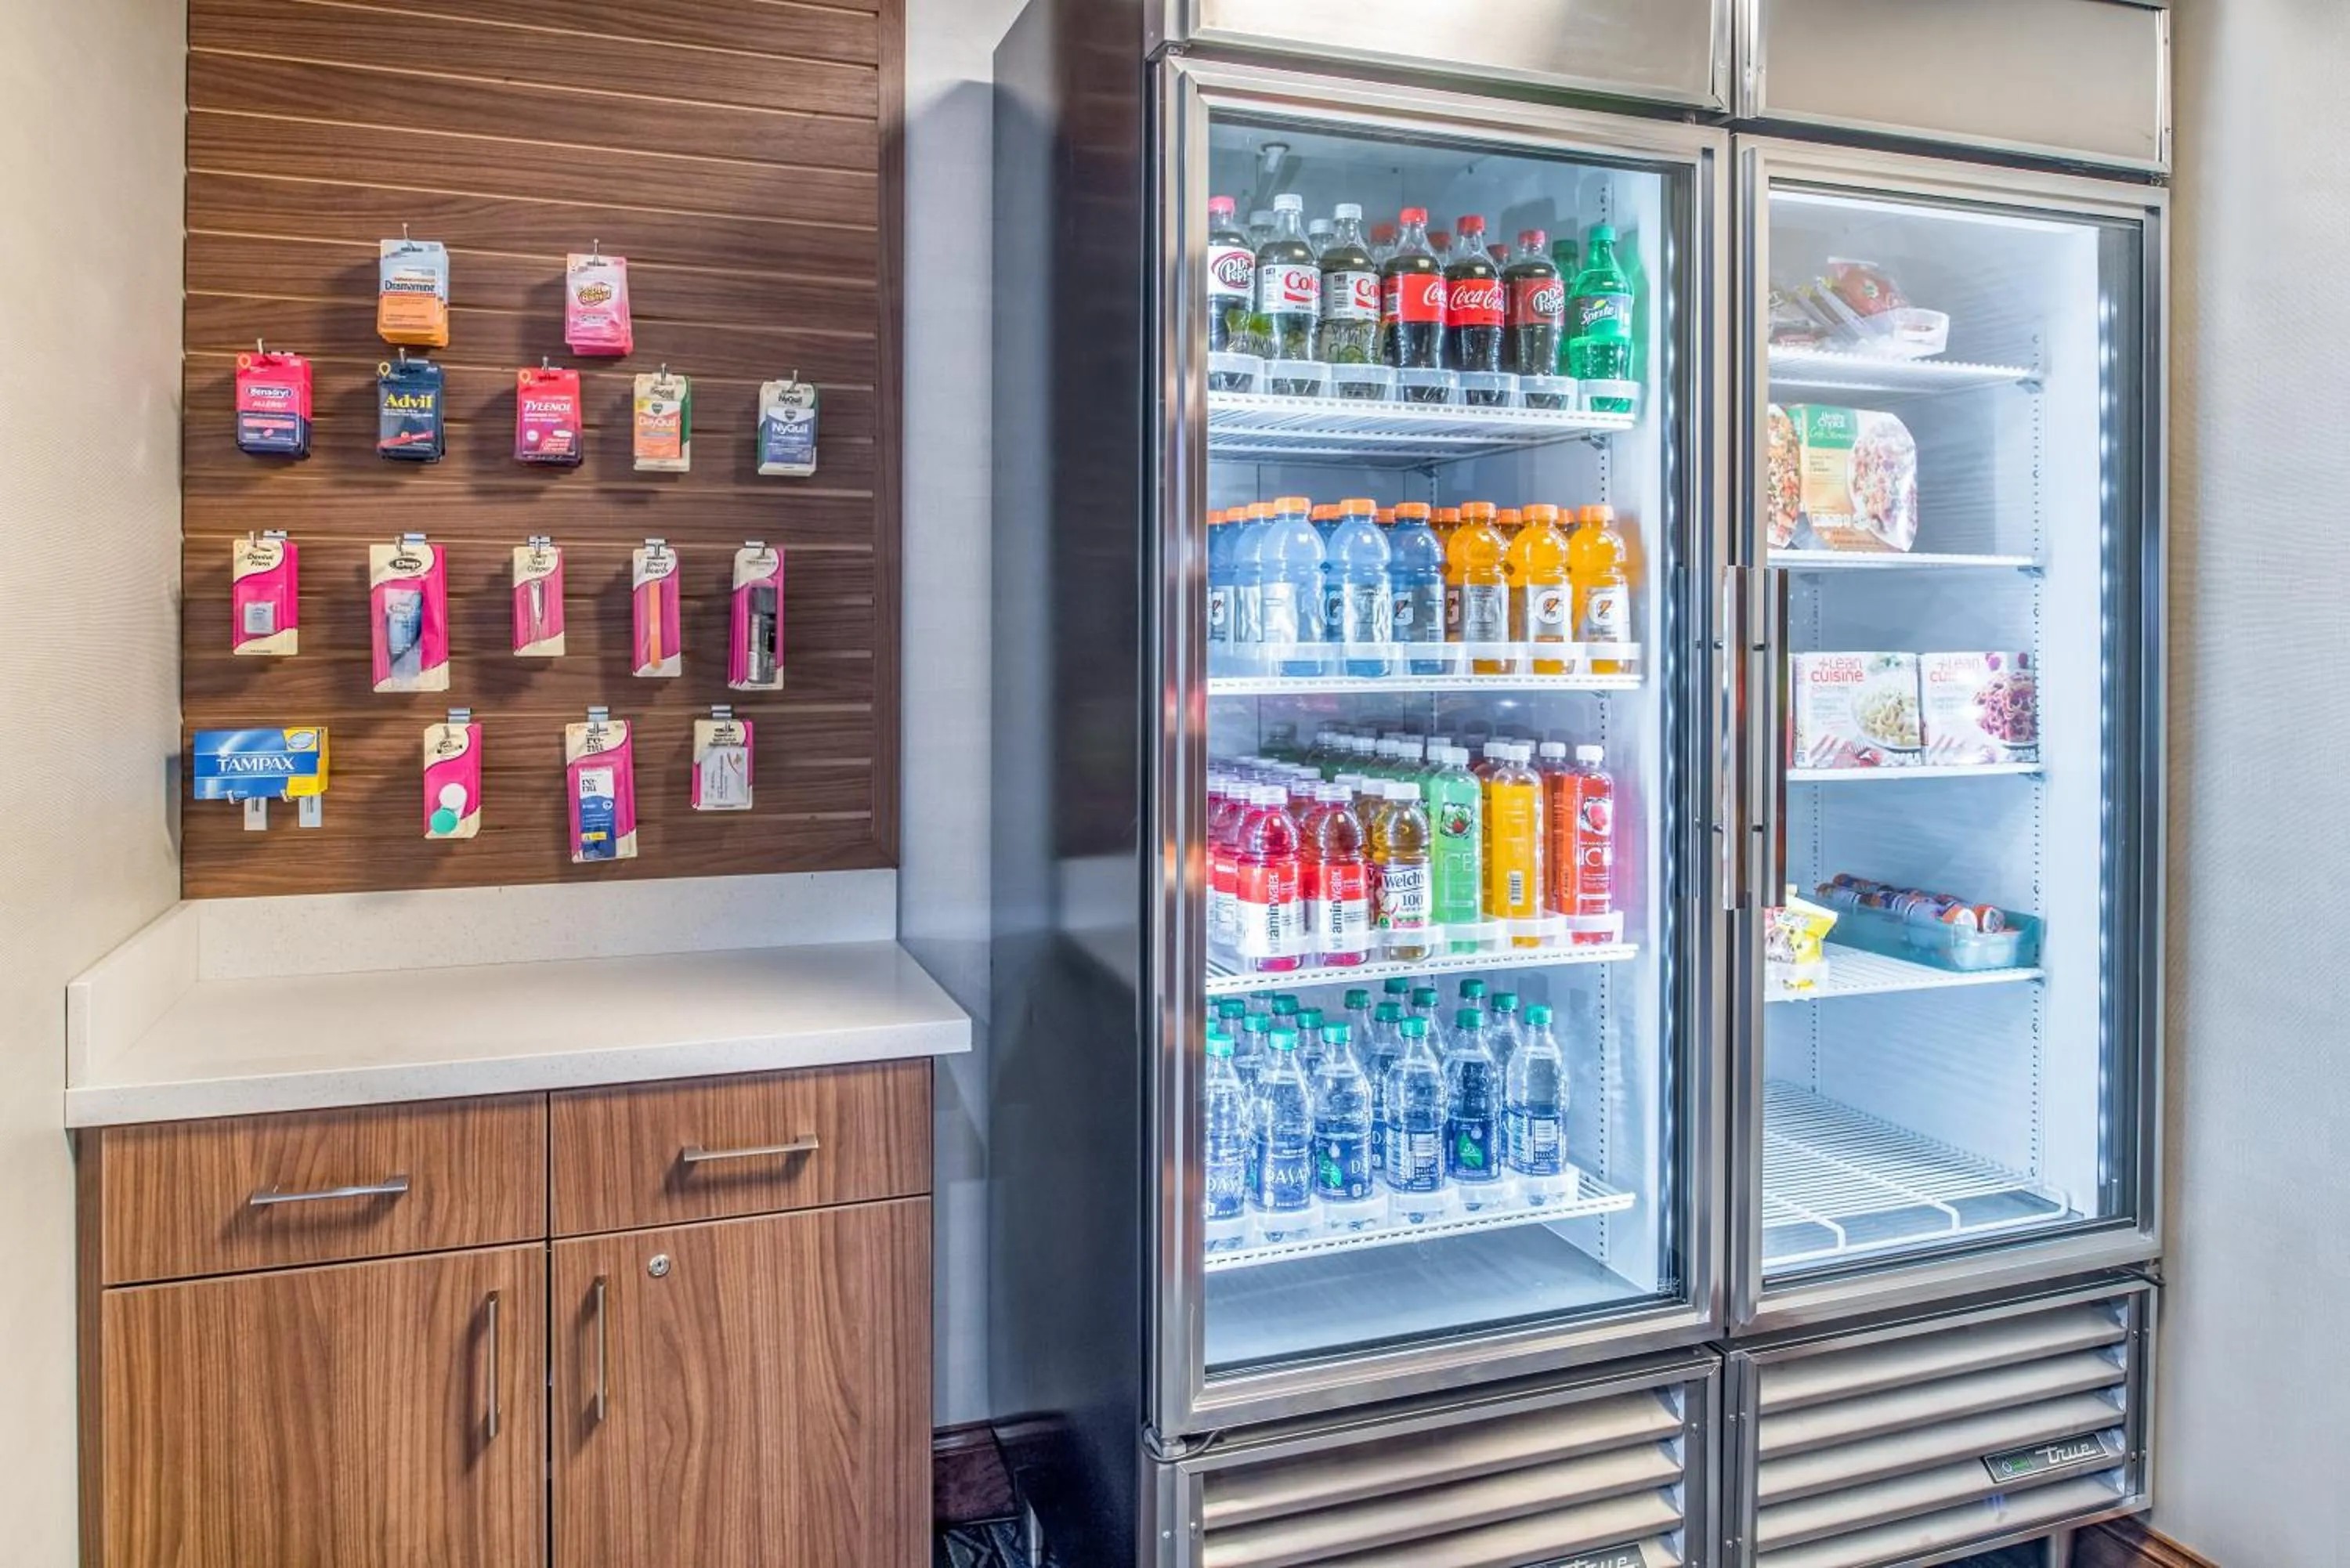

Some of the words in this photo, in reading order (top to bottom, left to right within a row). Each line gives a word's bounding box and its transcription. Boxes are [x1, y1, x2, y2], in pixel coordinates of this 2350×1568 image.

[384, 393, 433, 409] Advil
[524, 400, 571, 412] TYLENOL
[772, 423, 808, 435] NyQuil
[1810, 670, 1864, 683] cuisine
[215, 757, 295, 772] TAMPAX
